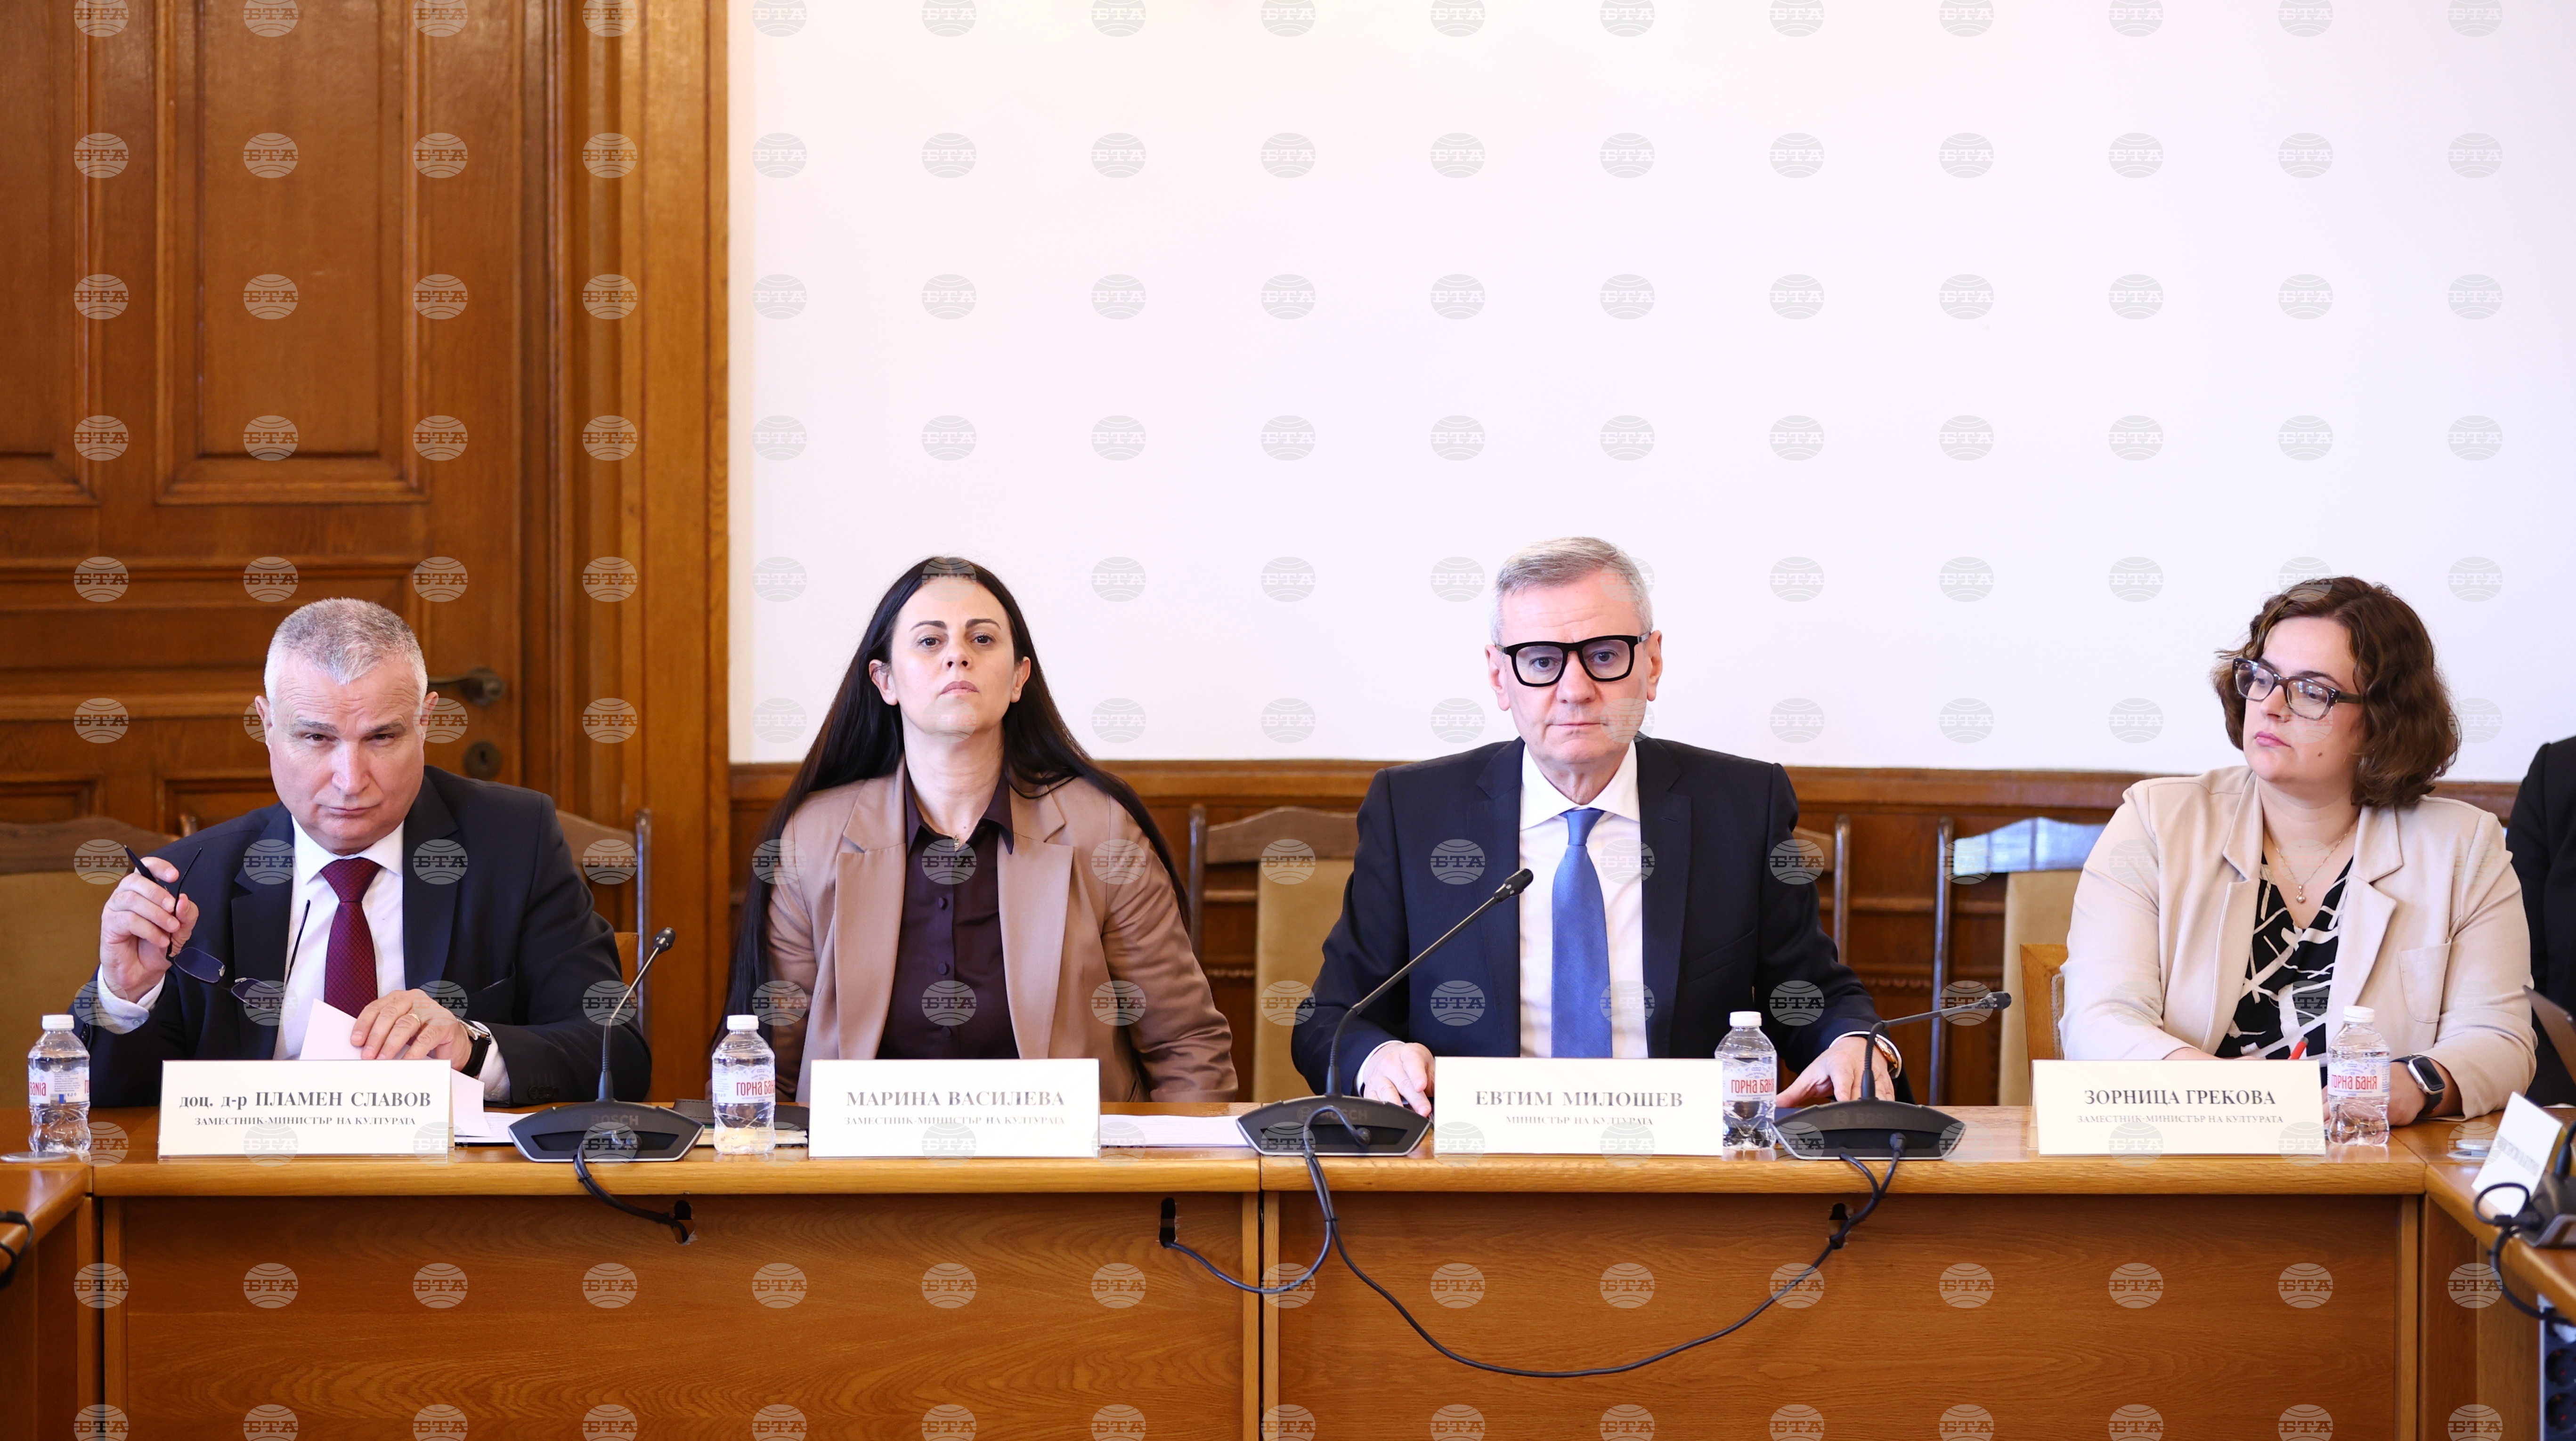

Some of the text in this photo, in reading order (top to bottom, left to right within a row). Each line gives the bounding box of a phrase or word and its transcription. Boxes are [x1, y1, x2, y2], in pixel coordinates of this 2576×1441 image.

[179, 1092, 431, 1110] доц. д-р ПЛАМЕН СЛАВОВ
[847, 1091, 1065, 1106] МАРИНА ВАСИЛЕВА
[1476, 1091, 1683, 1107] ЕВТИМ МИЛОШЕВ
[2084, 1090, 2276, 1106] ЗОРНИЦА ГРЕКОВА
[195, 1117, 333, 1125] ЗАМЕСТНИК-МИНИСТЪР
[355, 1117, 415, 1125] КУЛТУРАТА
[844, 1117, 982, 1125] ЗАМЕСТНИК-МИНИСТЪР
[1506, 1116, 1570, 1124] МИНИСТЪР
[1593, 1117, 1653, 1125] КУЛТУРАТА
[2077, 1115, 2206, 1124] ЗАМЕСТНИК-МИНИСТЪР
